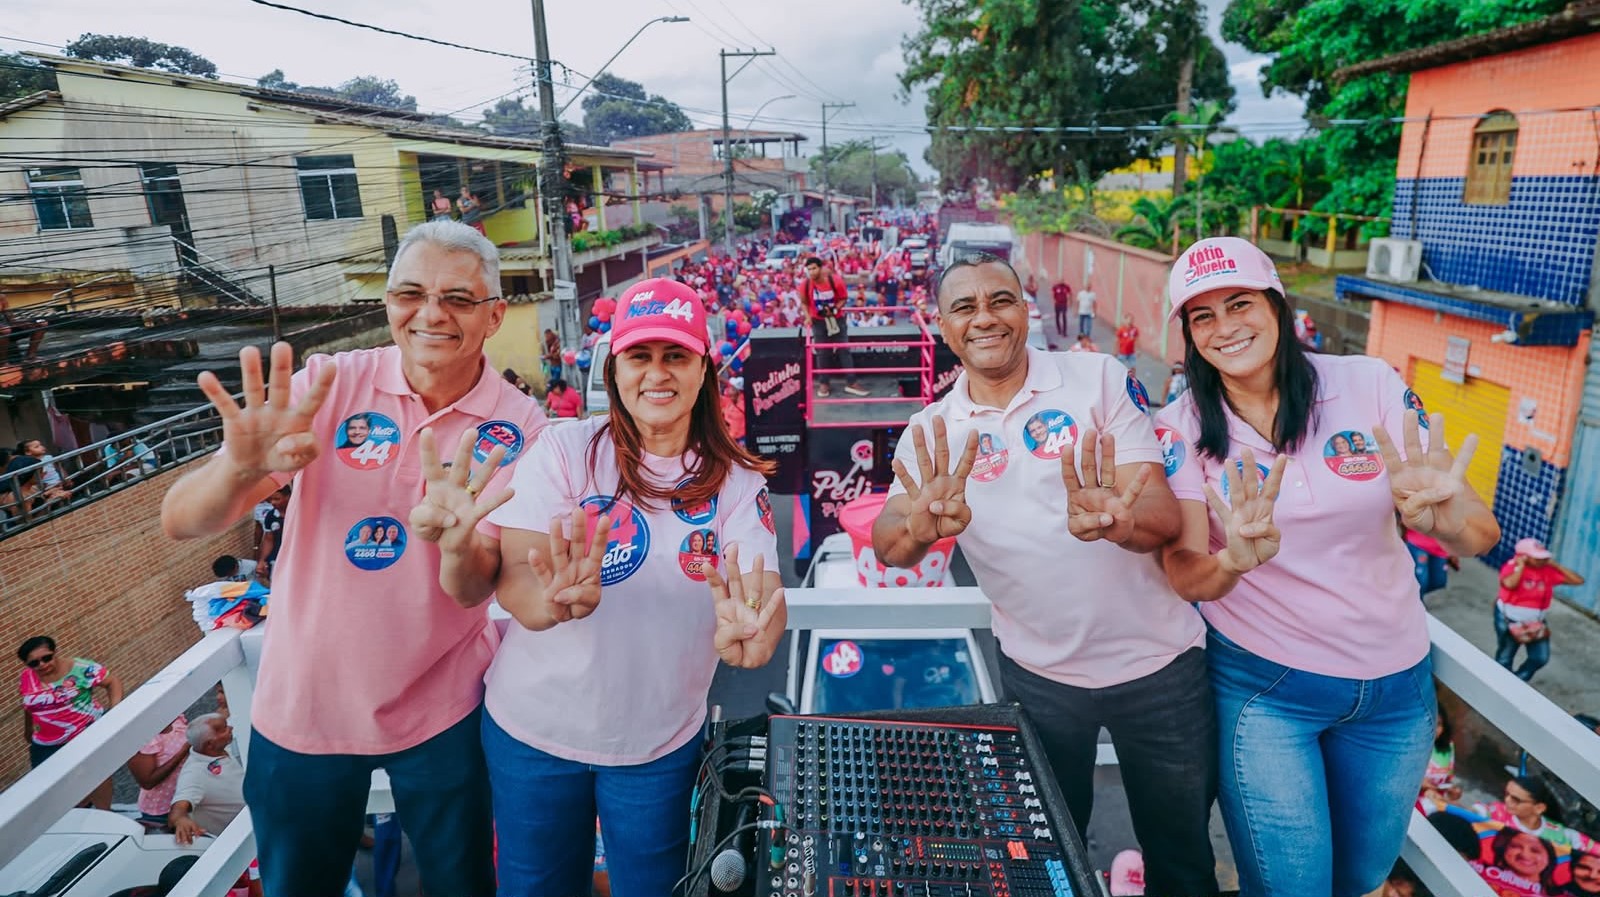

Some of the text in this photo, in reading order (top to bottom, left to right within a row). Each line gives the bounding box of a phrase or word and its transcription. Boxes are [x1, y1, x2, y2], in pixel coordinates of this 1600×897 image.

[624, 297, 694, 324] Neto 44
[371, 425, 396, 437] Neto
[489, 425, 516, 447] 222
[1043, 426, 1074, 455] 44
[350, 439, 392, 466] 44
[600, 542, 638, 568] eto
[831, 643, 859, 675] 44
